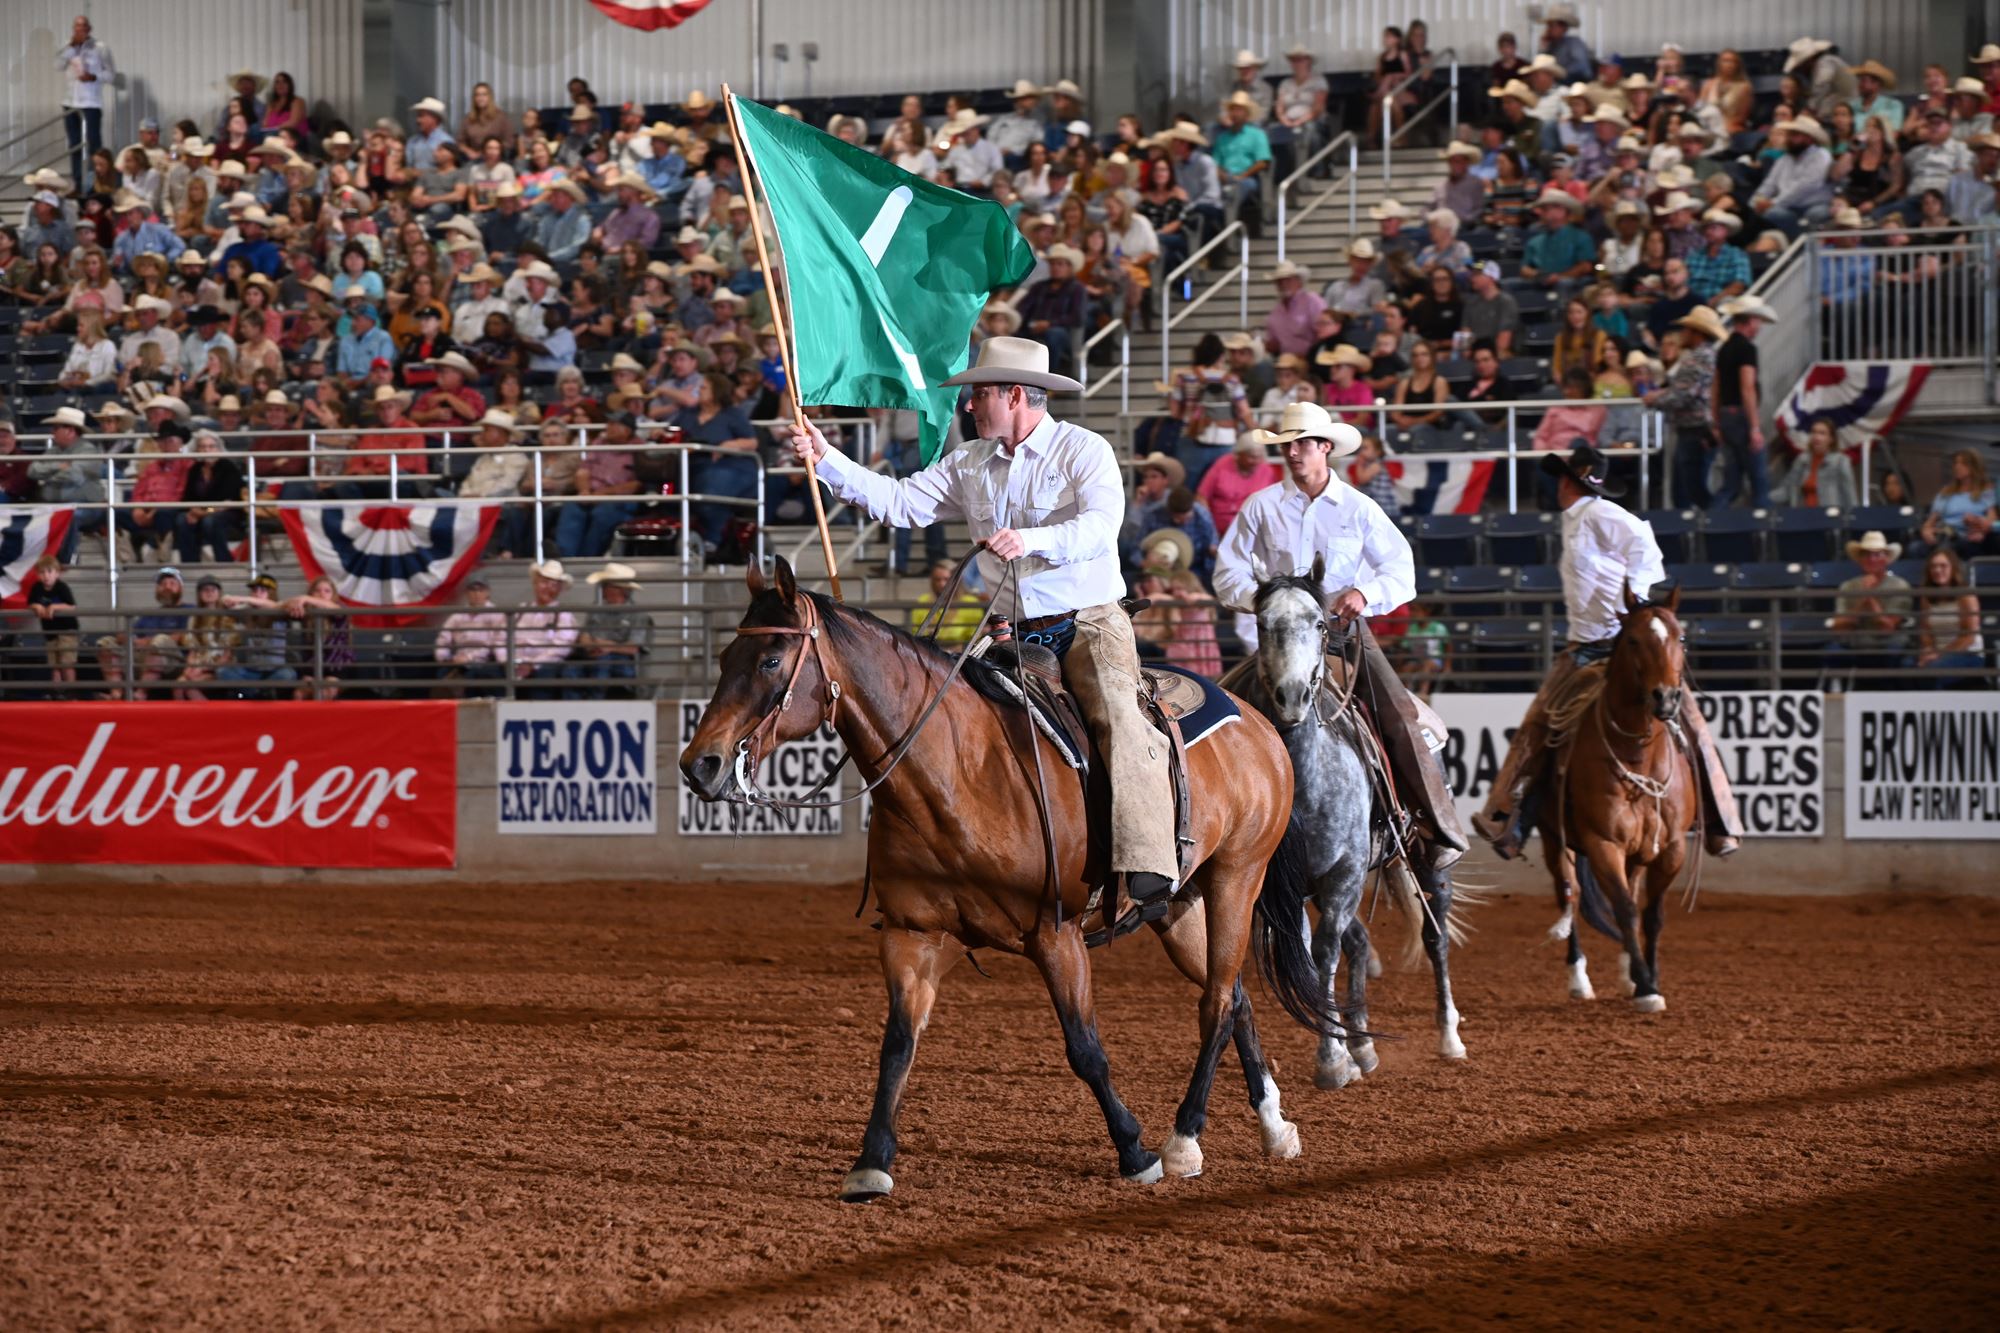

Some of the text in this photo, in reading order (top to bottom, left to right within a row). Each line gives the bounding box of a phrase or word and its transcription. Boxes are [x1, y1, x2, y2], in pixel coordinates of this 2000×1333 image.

[503, 719, 649, 779] TEJON
[1861, 711, 1999, 783] BROWNIN
[500, 781, 652, 822] EXPLORATION
[682, 792, 722, 831] JOE
[1860, 786, 1904, 820] LAW
[1911, 786, 1961, 820] FIRM
